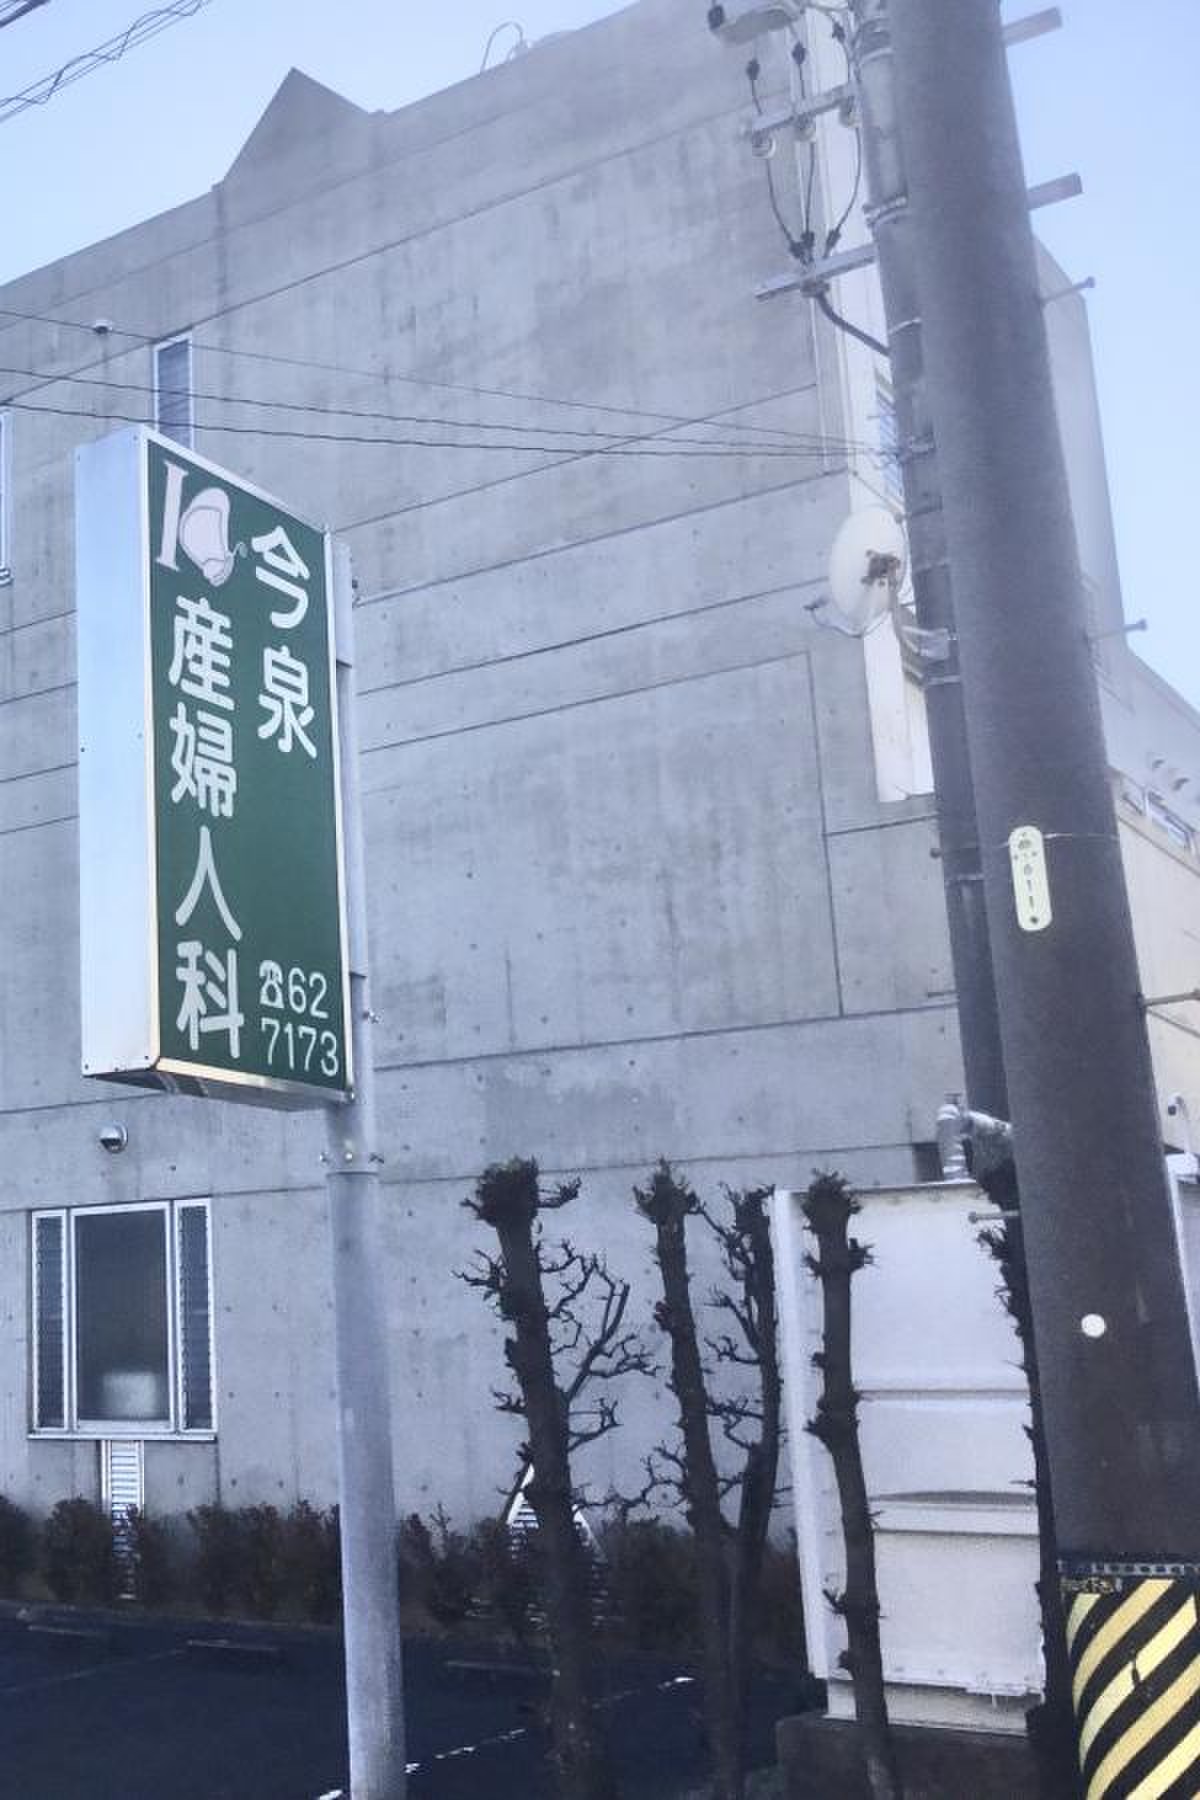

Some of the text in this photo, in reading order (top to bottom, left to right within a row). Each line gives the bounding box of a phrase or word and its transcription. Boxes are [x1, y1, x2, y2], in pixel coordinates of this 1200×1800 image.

[251, 525, 318, 759] 今泉
[168, 593, 245, 1059] 産婦人科
[261, 1017, 339, 1077] 7173
